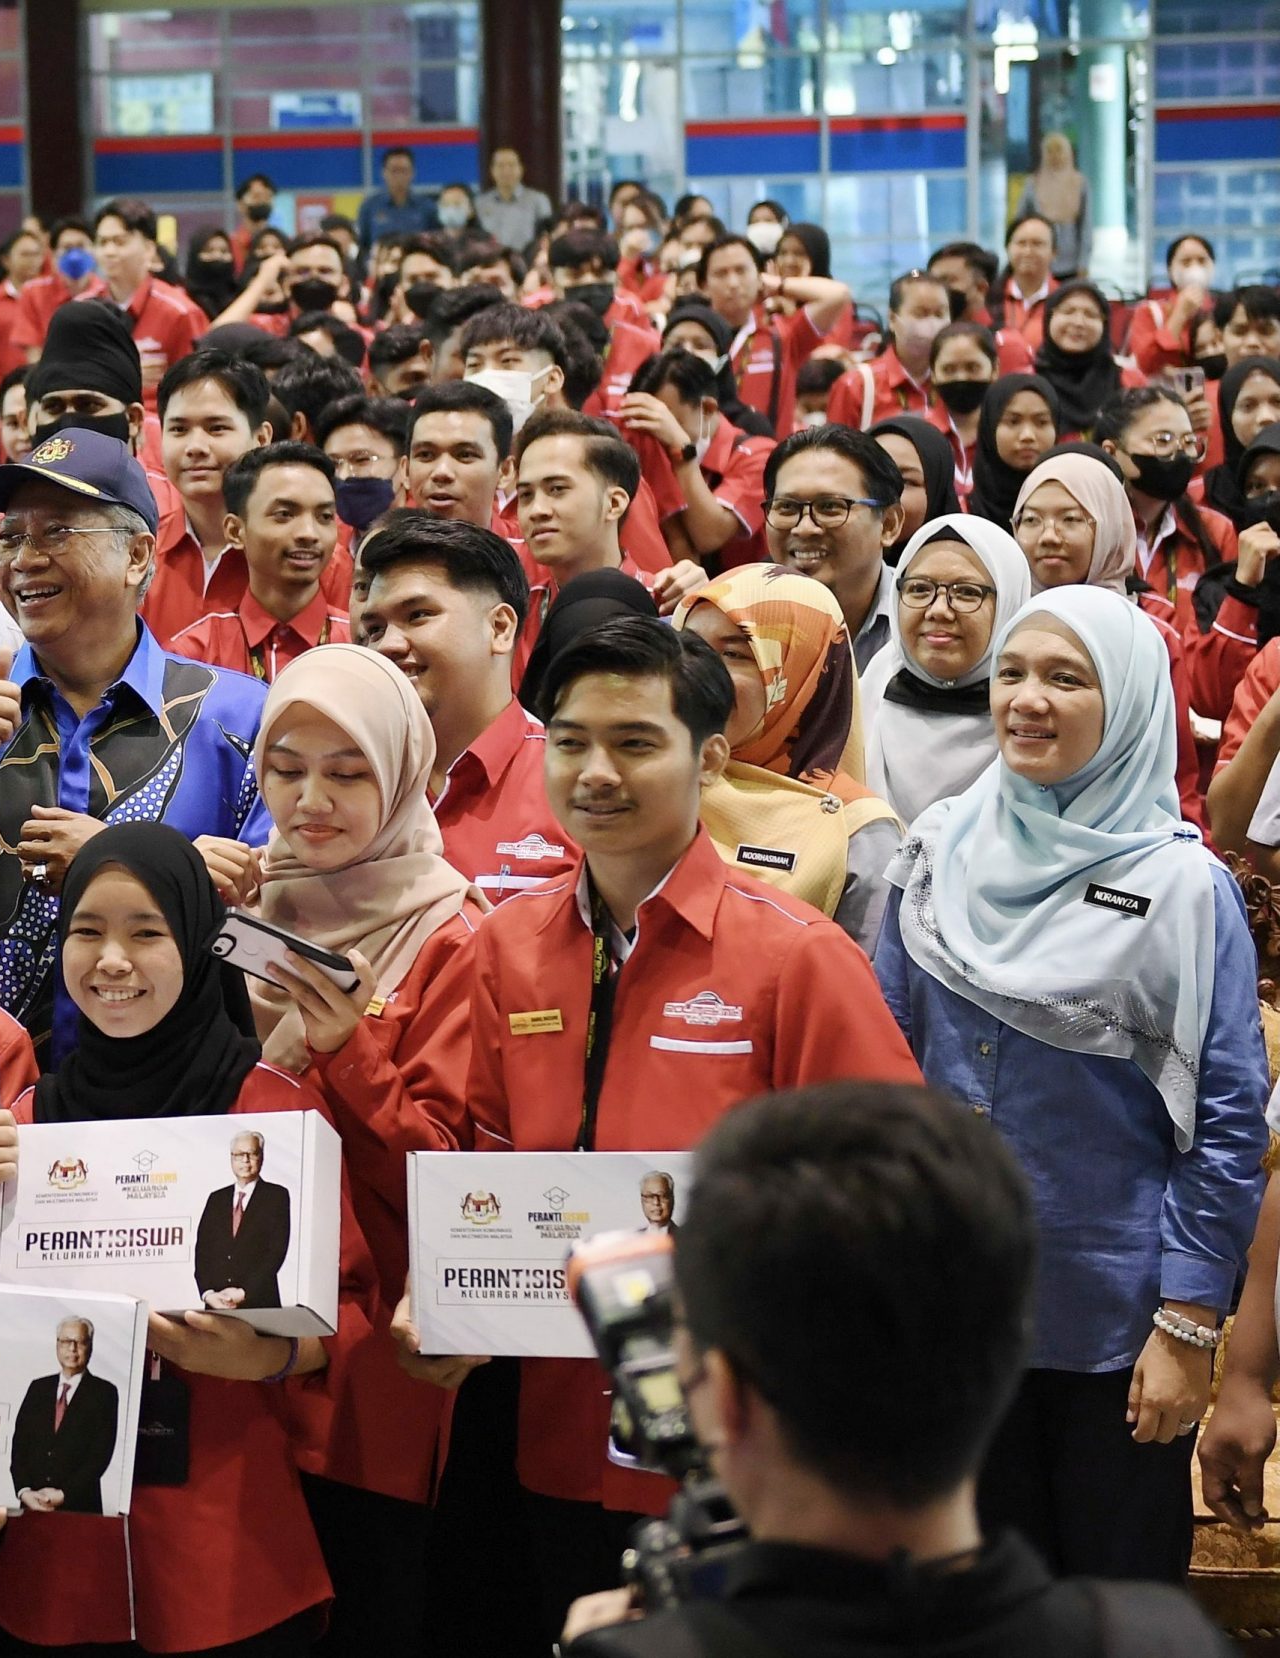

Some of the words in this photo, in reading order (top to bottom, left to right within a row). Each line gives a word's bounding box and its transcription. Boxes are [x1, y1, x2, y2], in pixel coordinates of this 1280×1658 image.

[1094, 890, 1139, 910] NORANYZA
[26, 1226, 184, 1252] PERANTISISWA
[42, 1250, 100, 1261] KELUARGA
[105, 1248, 164, 1259] MALAYSIA
[444, 1268, 566, 1289] PERANTISIS
[461, 1290, 518, 1300] KELUARGA
[523, 1290, 570, 1300] MALAYS
